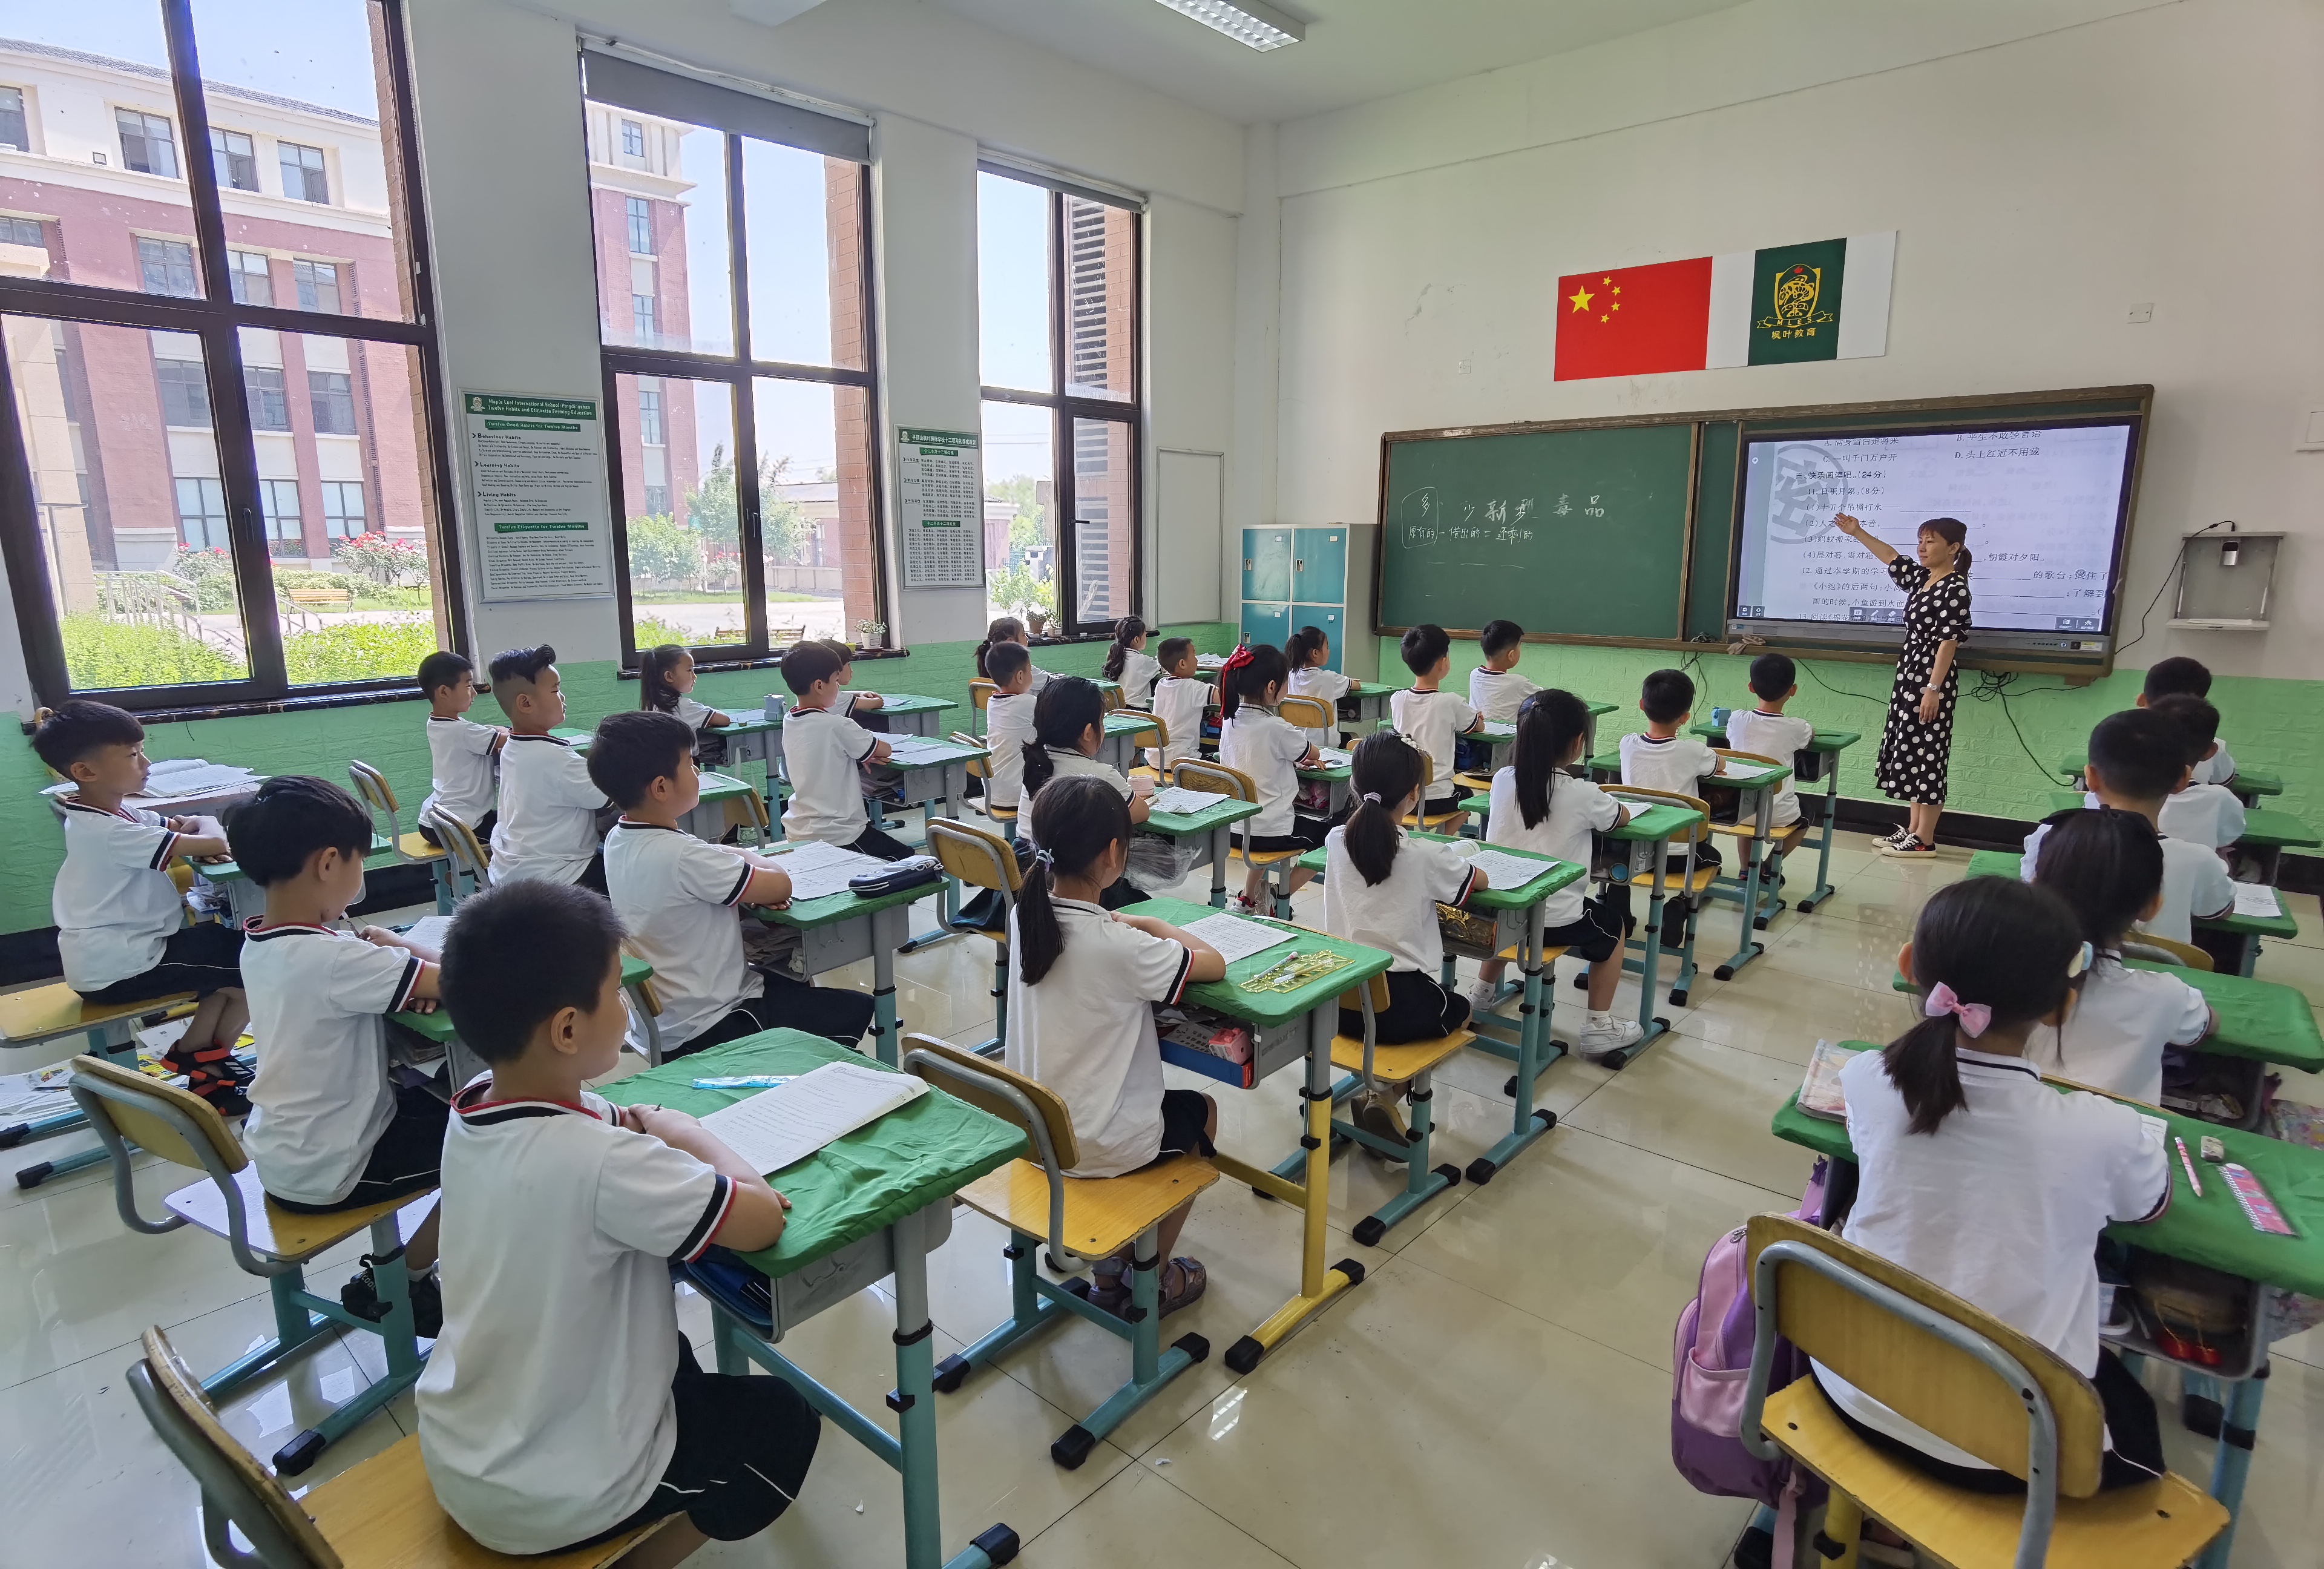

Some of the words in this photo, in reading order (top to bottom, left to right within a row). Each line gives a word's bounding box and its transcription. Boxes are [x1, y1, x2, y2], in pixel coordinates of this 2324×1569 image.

[1771, 327, 1816, 340] 枫叶教育
[1834, 453, 1897, 462] 一叫千门万户开
[1966, 447, 2040, 459] 头上红冠不用裁
